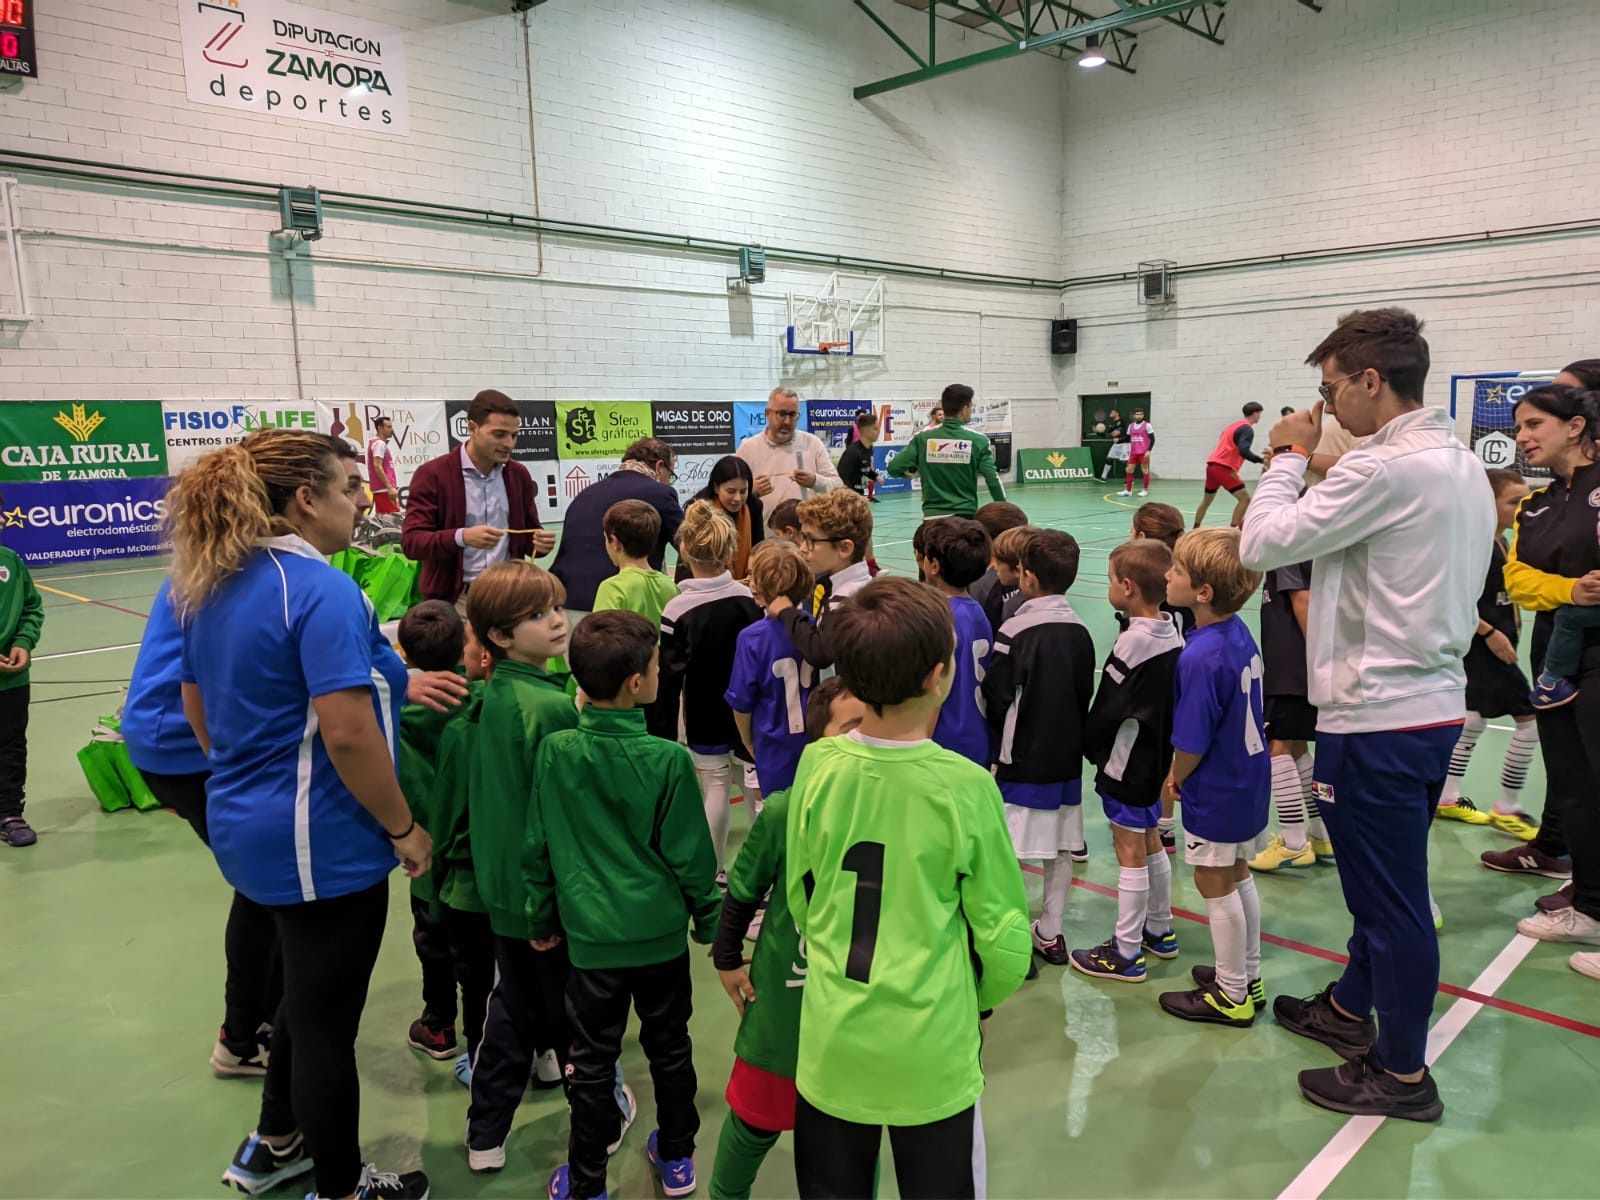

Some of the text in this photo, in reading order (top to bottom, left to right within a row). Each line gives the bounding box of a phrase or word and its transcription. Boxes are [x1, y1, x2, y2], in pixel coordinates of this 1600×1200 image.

[266, 48, 392, 97] ZAMORA
[210, 74, 391, 125] deportes
[164, 411, 228, 430] FISIO
[260, 411, 316, 428] LIFE
[656, 410, 731, 422] MIGAS DE ORO
[167, 437, 222, 447] CENTROS
[1, 443, 159, 467] CAJA RURAL
[42, 468, 127, 481] DE ZAMORA
[1025, 468, 1093, 479] CAJA RURAL
[28, 495, 168, 527] euronics
[25, 548, 91, 561] VALDERADUEY
[93, 547, 125, 559] (Puerta
[841, 840, 885, 984] 1
